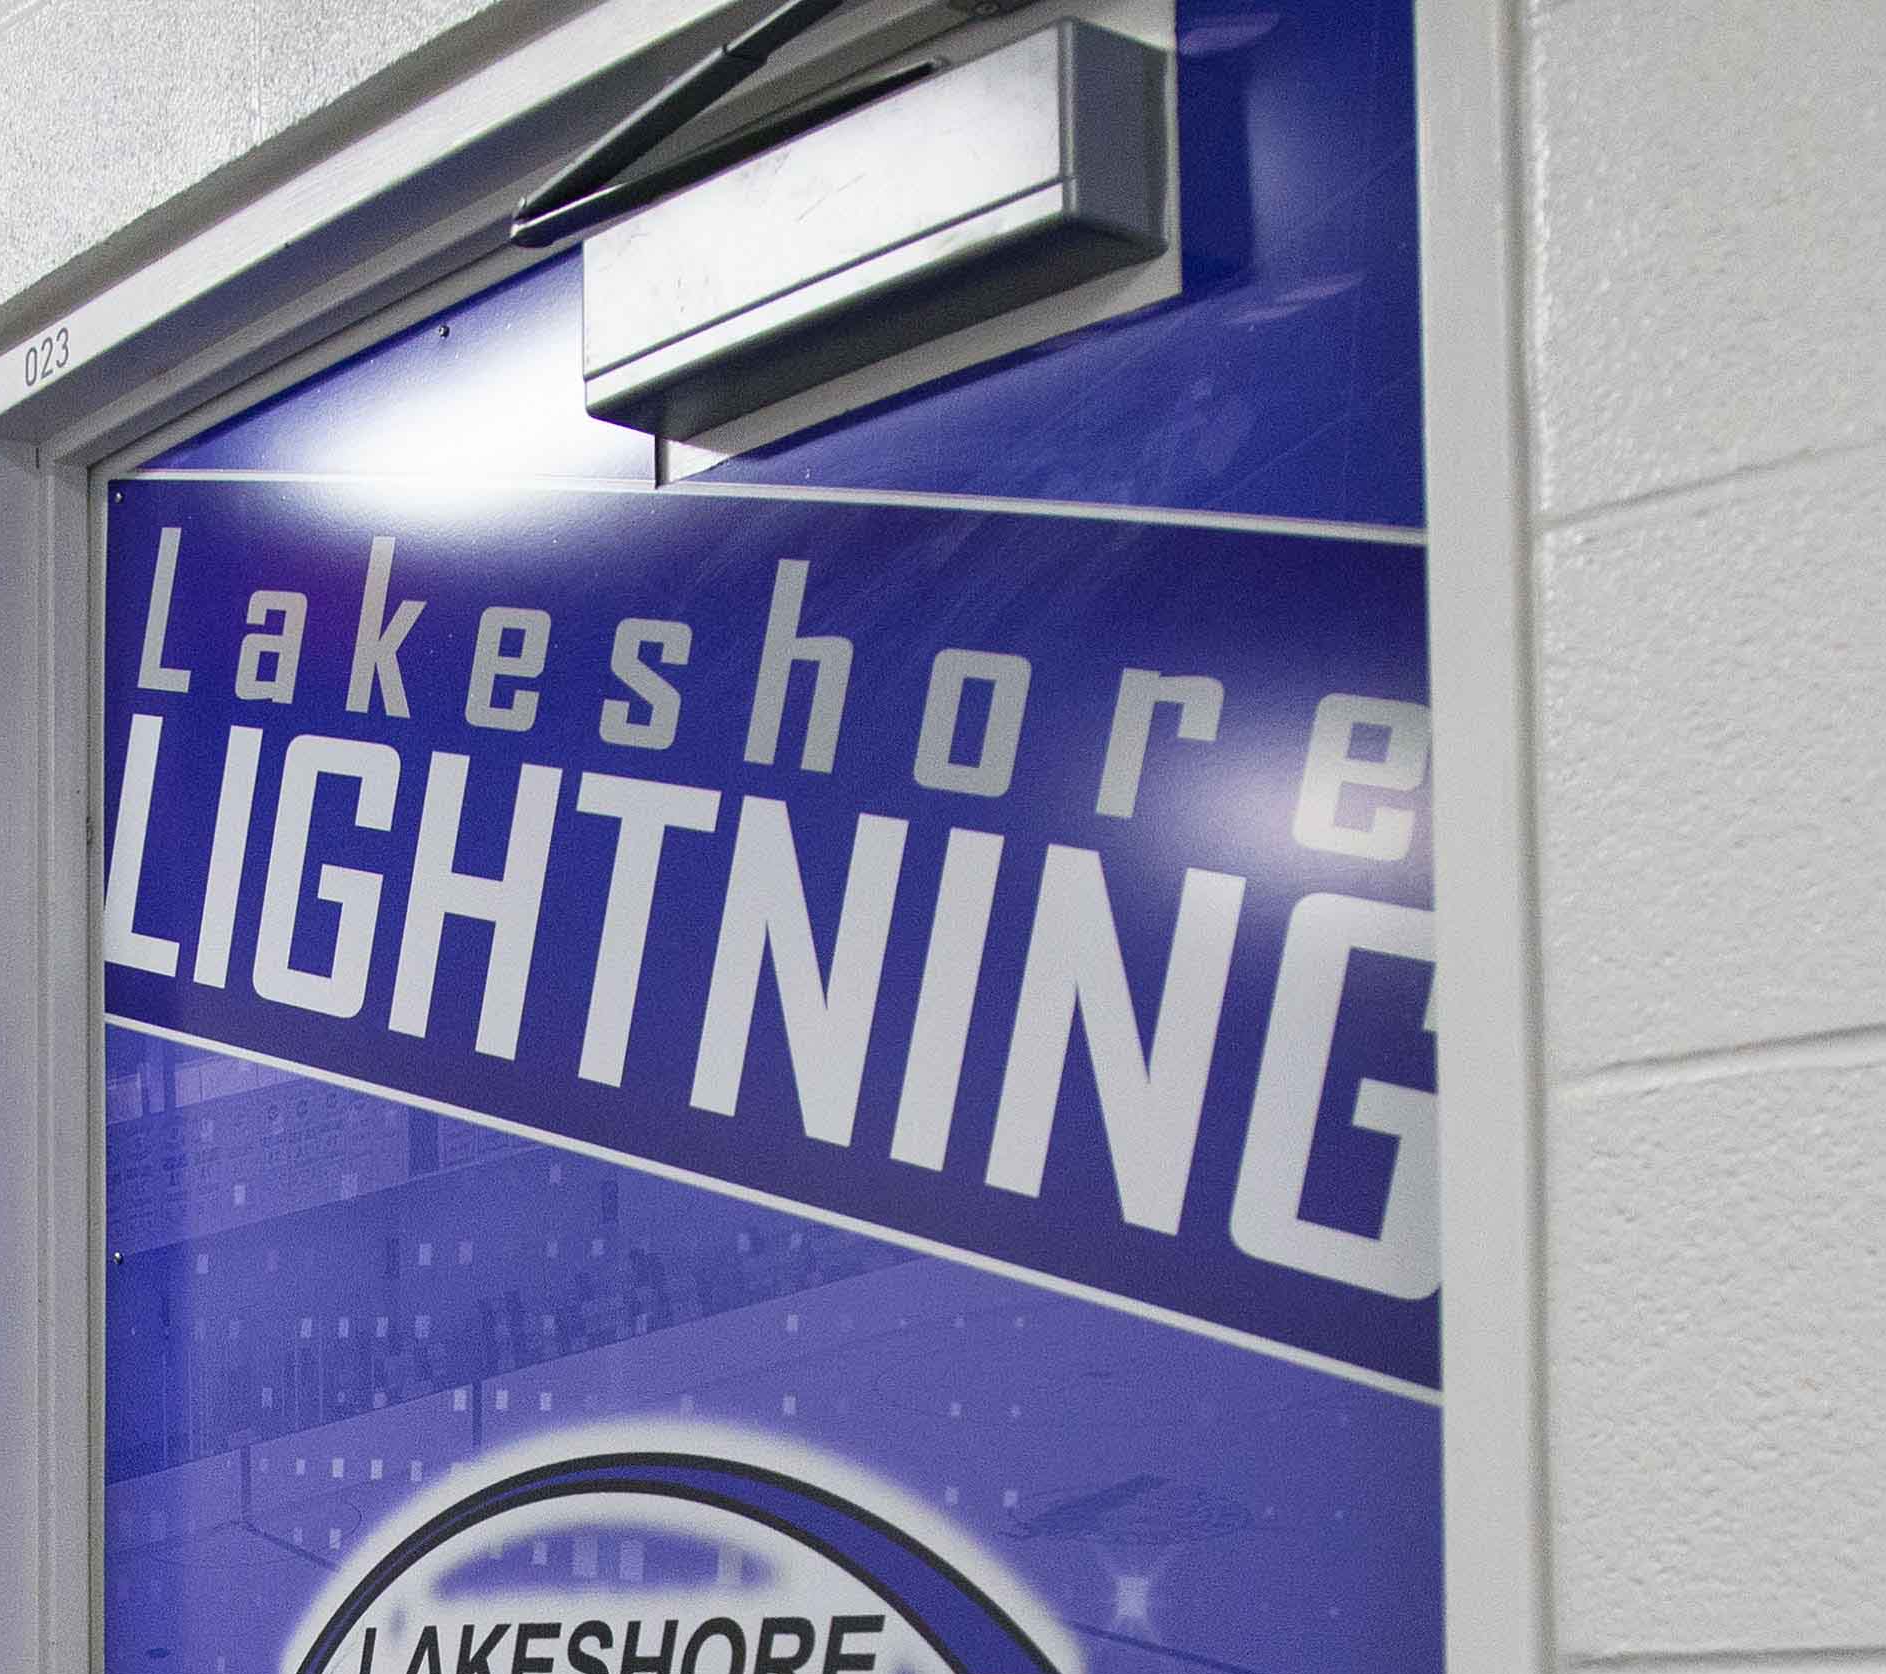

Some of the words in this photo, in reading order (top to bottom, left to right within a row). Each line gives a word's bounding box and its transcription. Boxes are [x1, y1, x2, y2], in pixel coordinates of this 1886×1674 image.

[25, 327, 69, 386] 023
[137, 524, 1432, 863] Lakeshore
[104, 709, 1441, 1303] LIGHTNING
